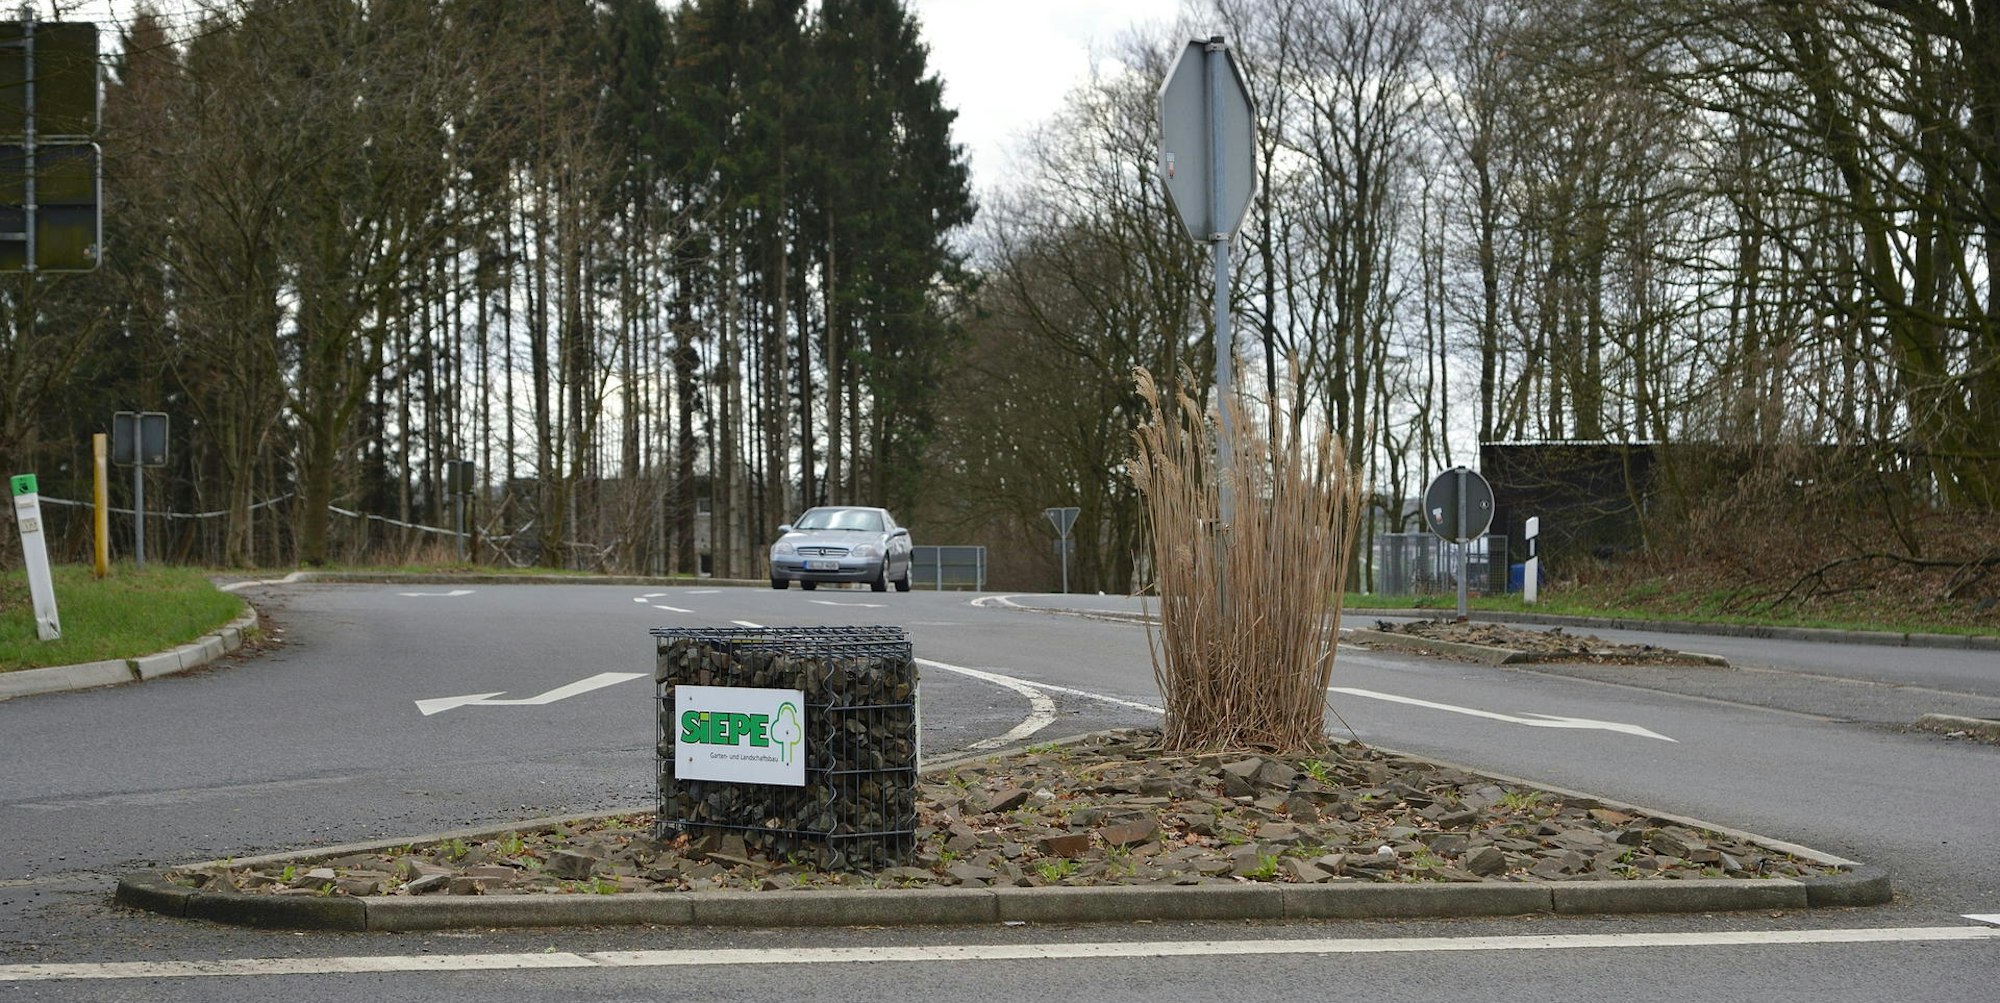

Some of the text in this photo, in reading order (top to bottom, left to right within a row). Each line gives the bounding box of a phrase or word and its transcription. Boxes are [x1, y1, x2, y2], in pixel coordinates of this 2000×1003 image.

[681, 710, 769, 747] SiEPE
[710, 752, 729, 760] Garten-
[740, 754, 779, 763] Landschaftsbau
